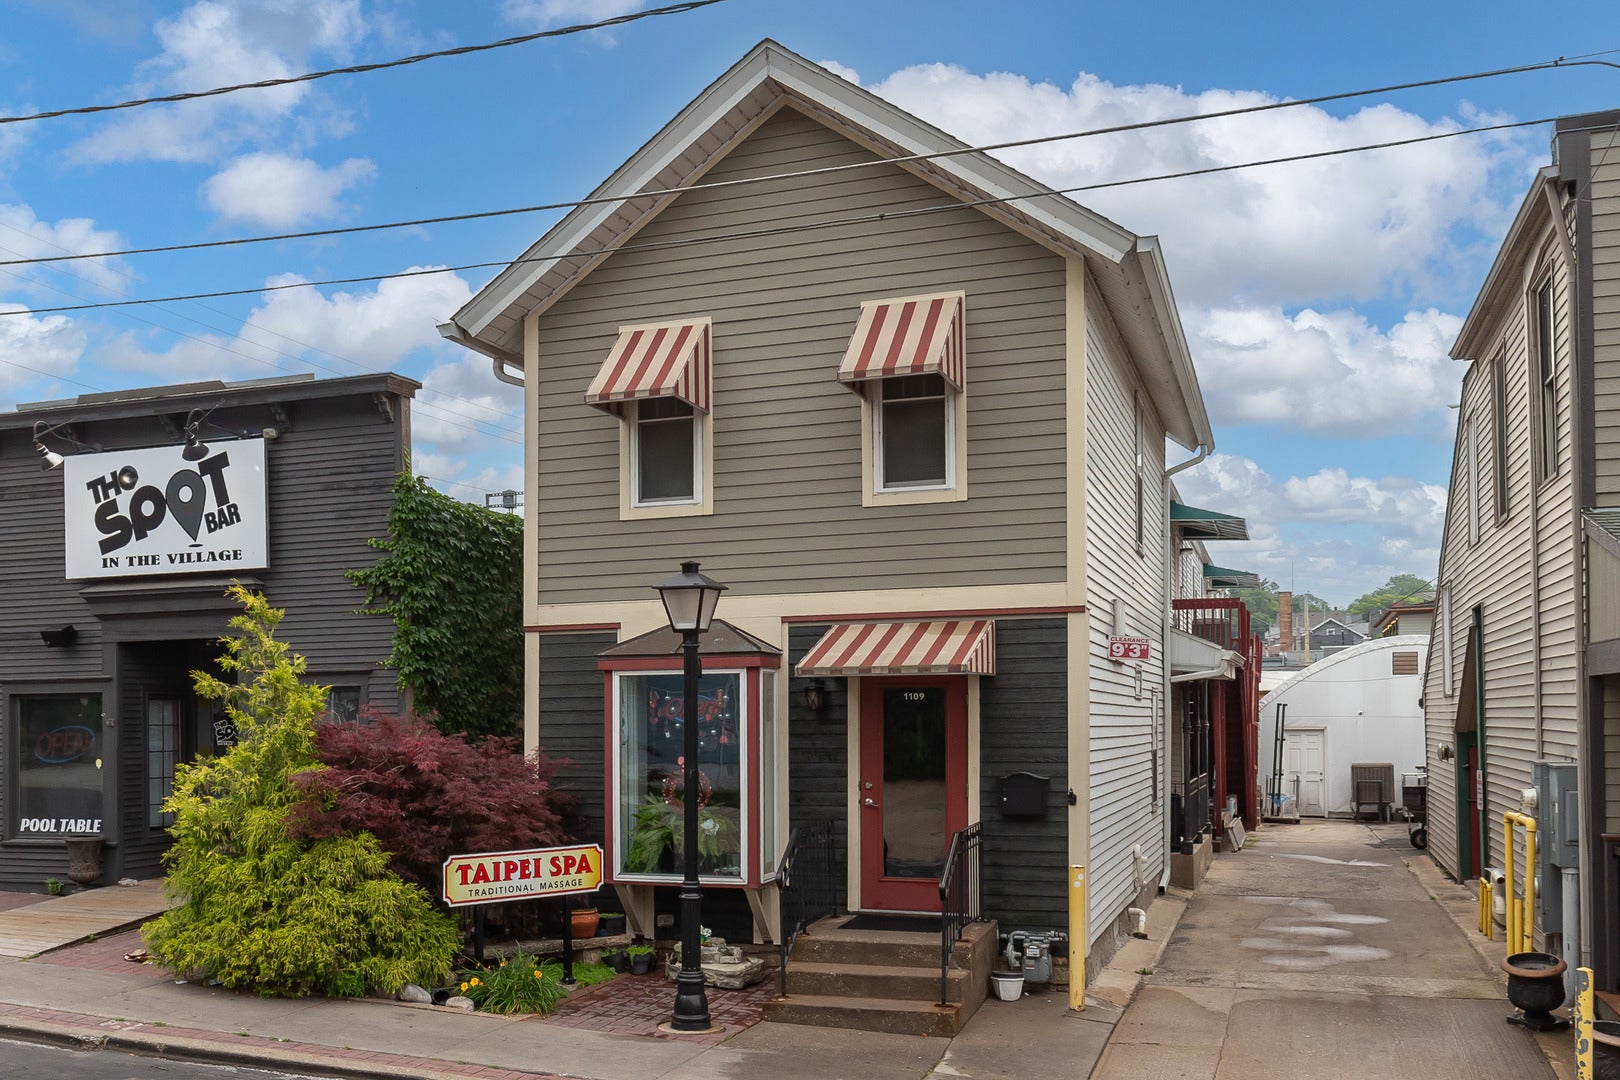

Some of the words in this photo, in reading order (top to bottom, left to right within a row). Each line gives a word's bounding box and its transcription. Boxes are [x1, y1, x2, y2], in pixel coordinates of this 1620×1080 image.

[94, 451, 230, 555] SPOT
[204, 503, 241, 534] BAR
[102, 556, 119, 568] IN
[126, 554, 160, 567] THE
[167, 549, 242, 564] VILLAGE
[903, 692, 925, 701] 1109
[36, 731, 90, 758] OPEN
[20, 818, 57, 832] POOL
[60, 819, 102, 833] TABLE
[455, 857, 542, 886] TAIPEI
[549, 853, 593, 877] SPA
[468, 884, 534, 897] TRADITIONAL
[539, 878, 583, 890] MASSAGE
